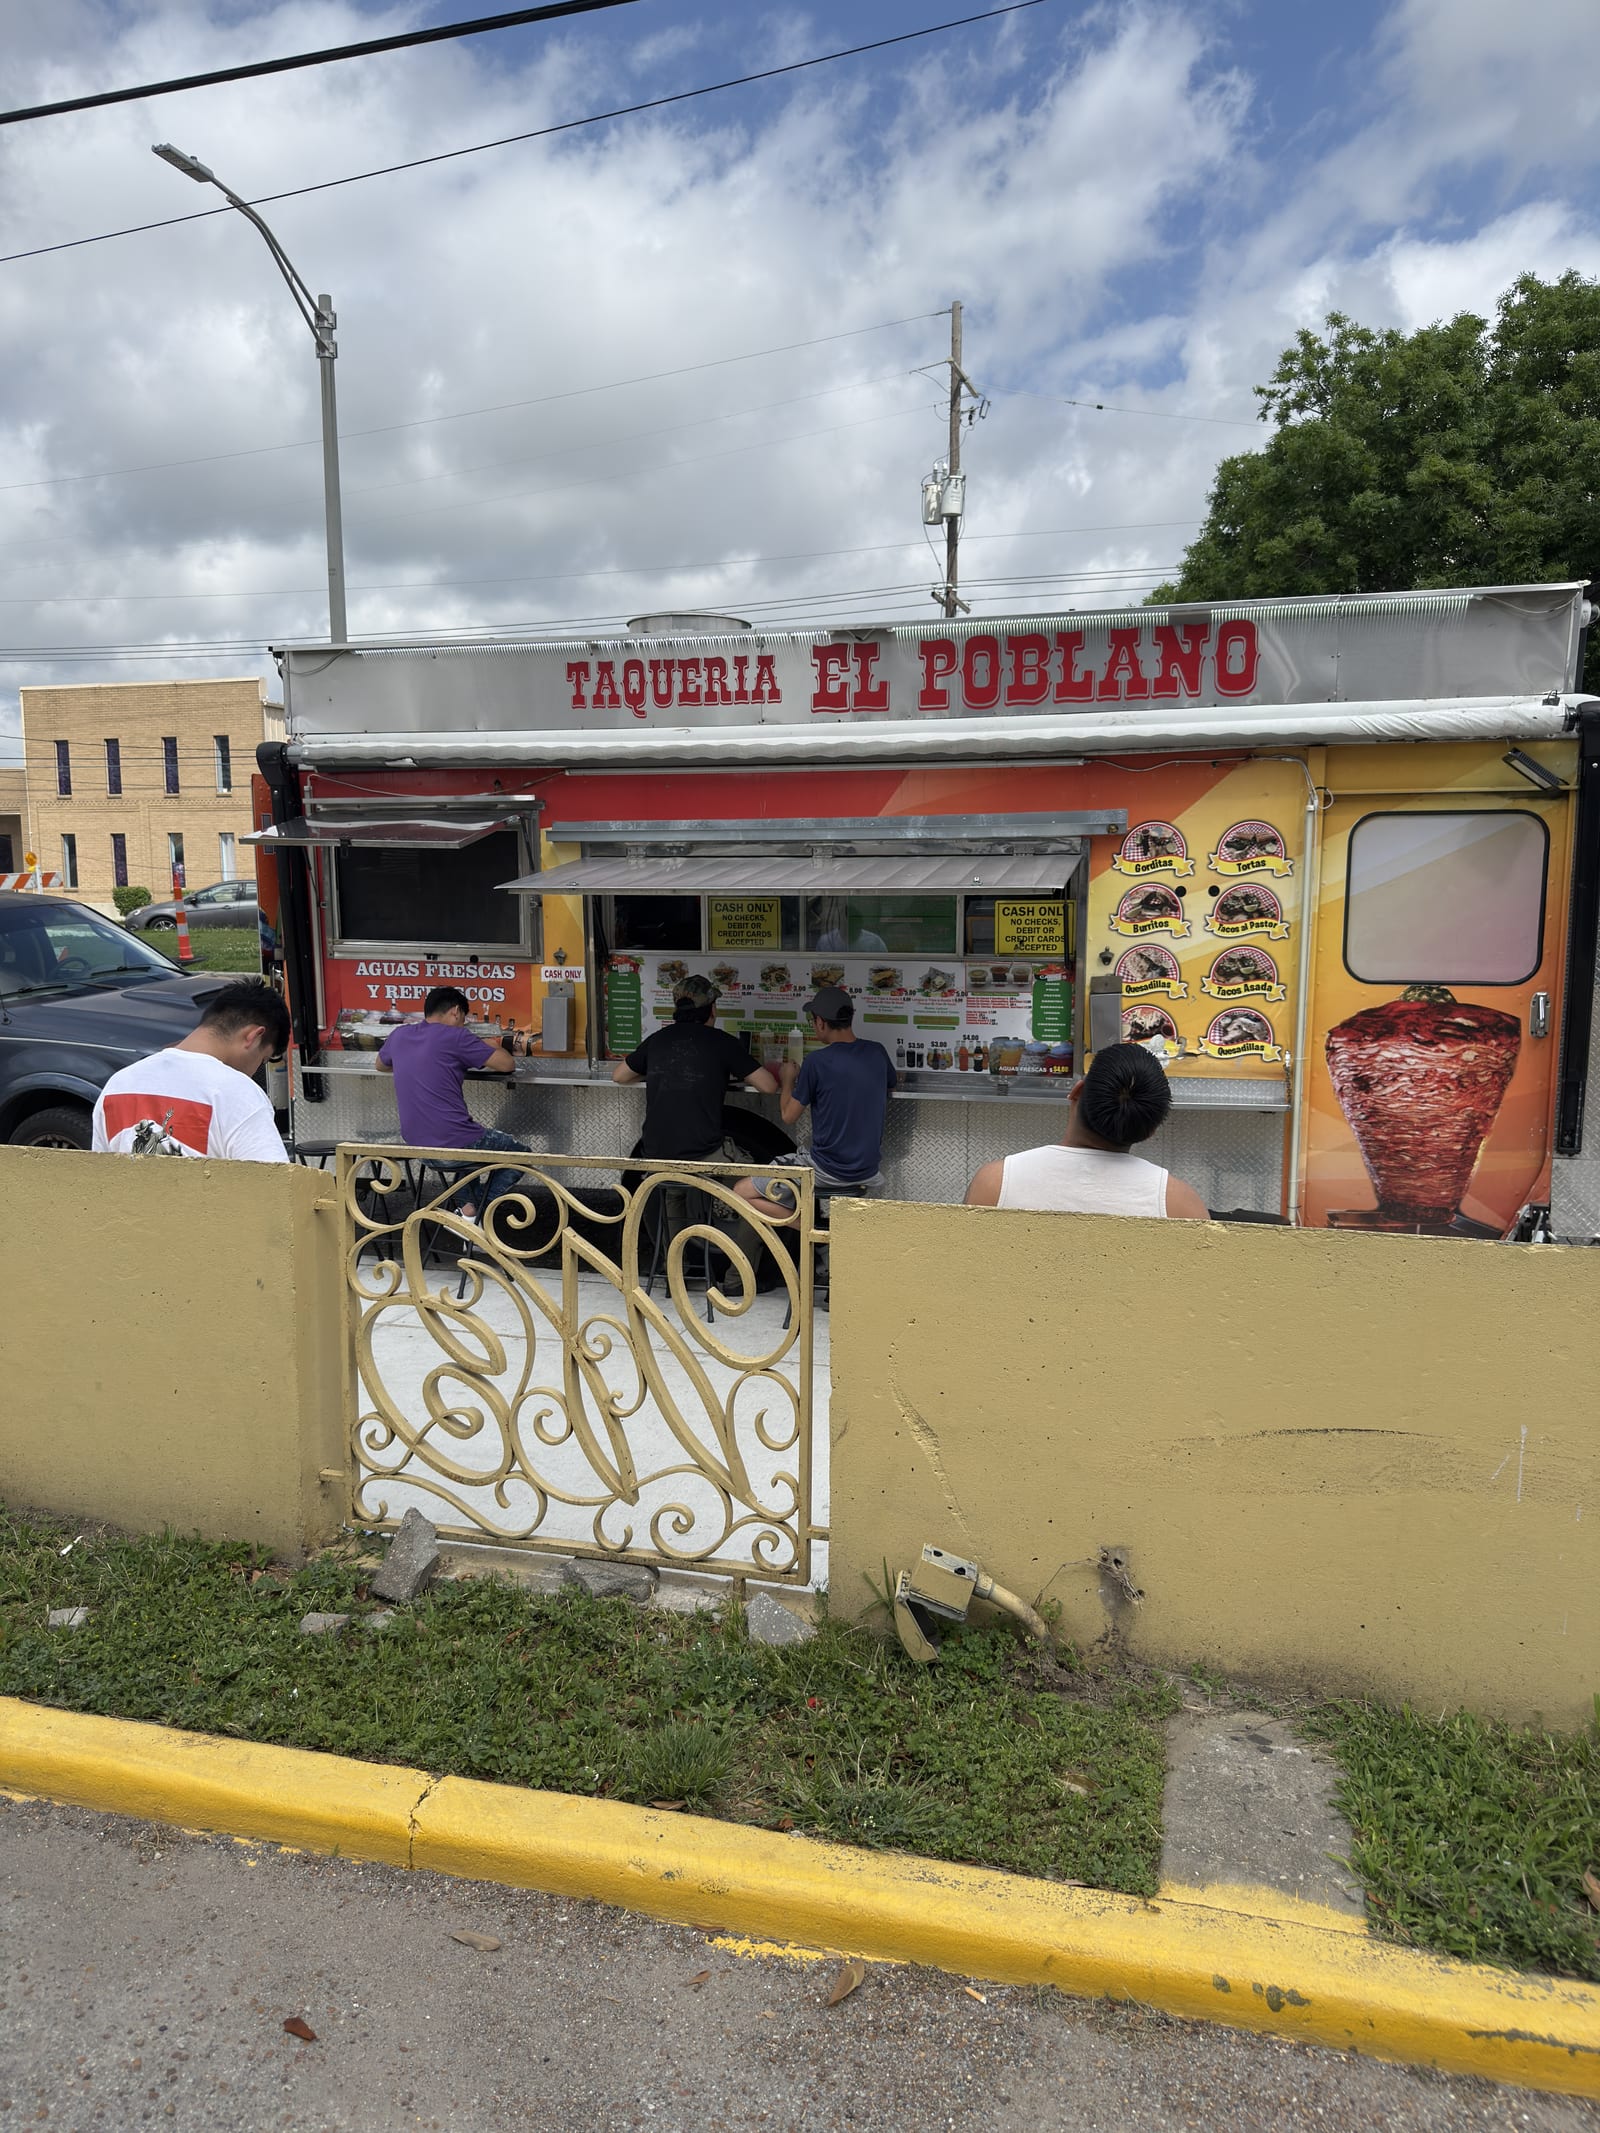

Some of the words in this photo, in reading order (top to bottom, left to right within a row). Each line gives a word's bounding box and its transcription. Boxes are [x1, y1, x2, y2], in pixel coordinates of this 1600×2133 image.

[566, 655, 781, 718] TAQUERIA
[810, 642, 890, 713] EL
[918, 620, 1261, 710] POBLANO
[1135, 859, 1173, 872] Gorditas
[1236, 859, 1266, 872] Tortas
[714, 903, 744, 913] CASH
[747, 903, 774, 913] ONLY
[1002, 906, 1034, 917] CASH
[1039, 906, 1064, 917] ONL
[1025, 919, 1061, 927] CHECKS,
[1133, 920, 1169, 933] Burritos
[1217, 923, 1240, 933] Tacos
[1250, 920, 1278, 930] Pastor
[746, 930, 772, 938] CARDS
[1005, 935, 1034, 943] CREDIT
[725, 938, 764, 946] ACCEPTED
[355, 962, 420, 977] AGUAS
[424, 963, 515, 980] FRESCAS
[544, 969, 562, 979] CASH
[564, 969, 582, 979] ONLY
[366, 984, 381, 999] Y
[384, 984, 505, 1002] REFCOS
[1125, 980, 1171, 993] Quesadillas
[1217, 986, 1242, 996] Tacos
[1243, 982, 1273, 992] Asada
[1217, 1043, 1265, 1056] Quesadillas
